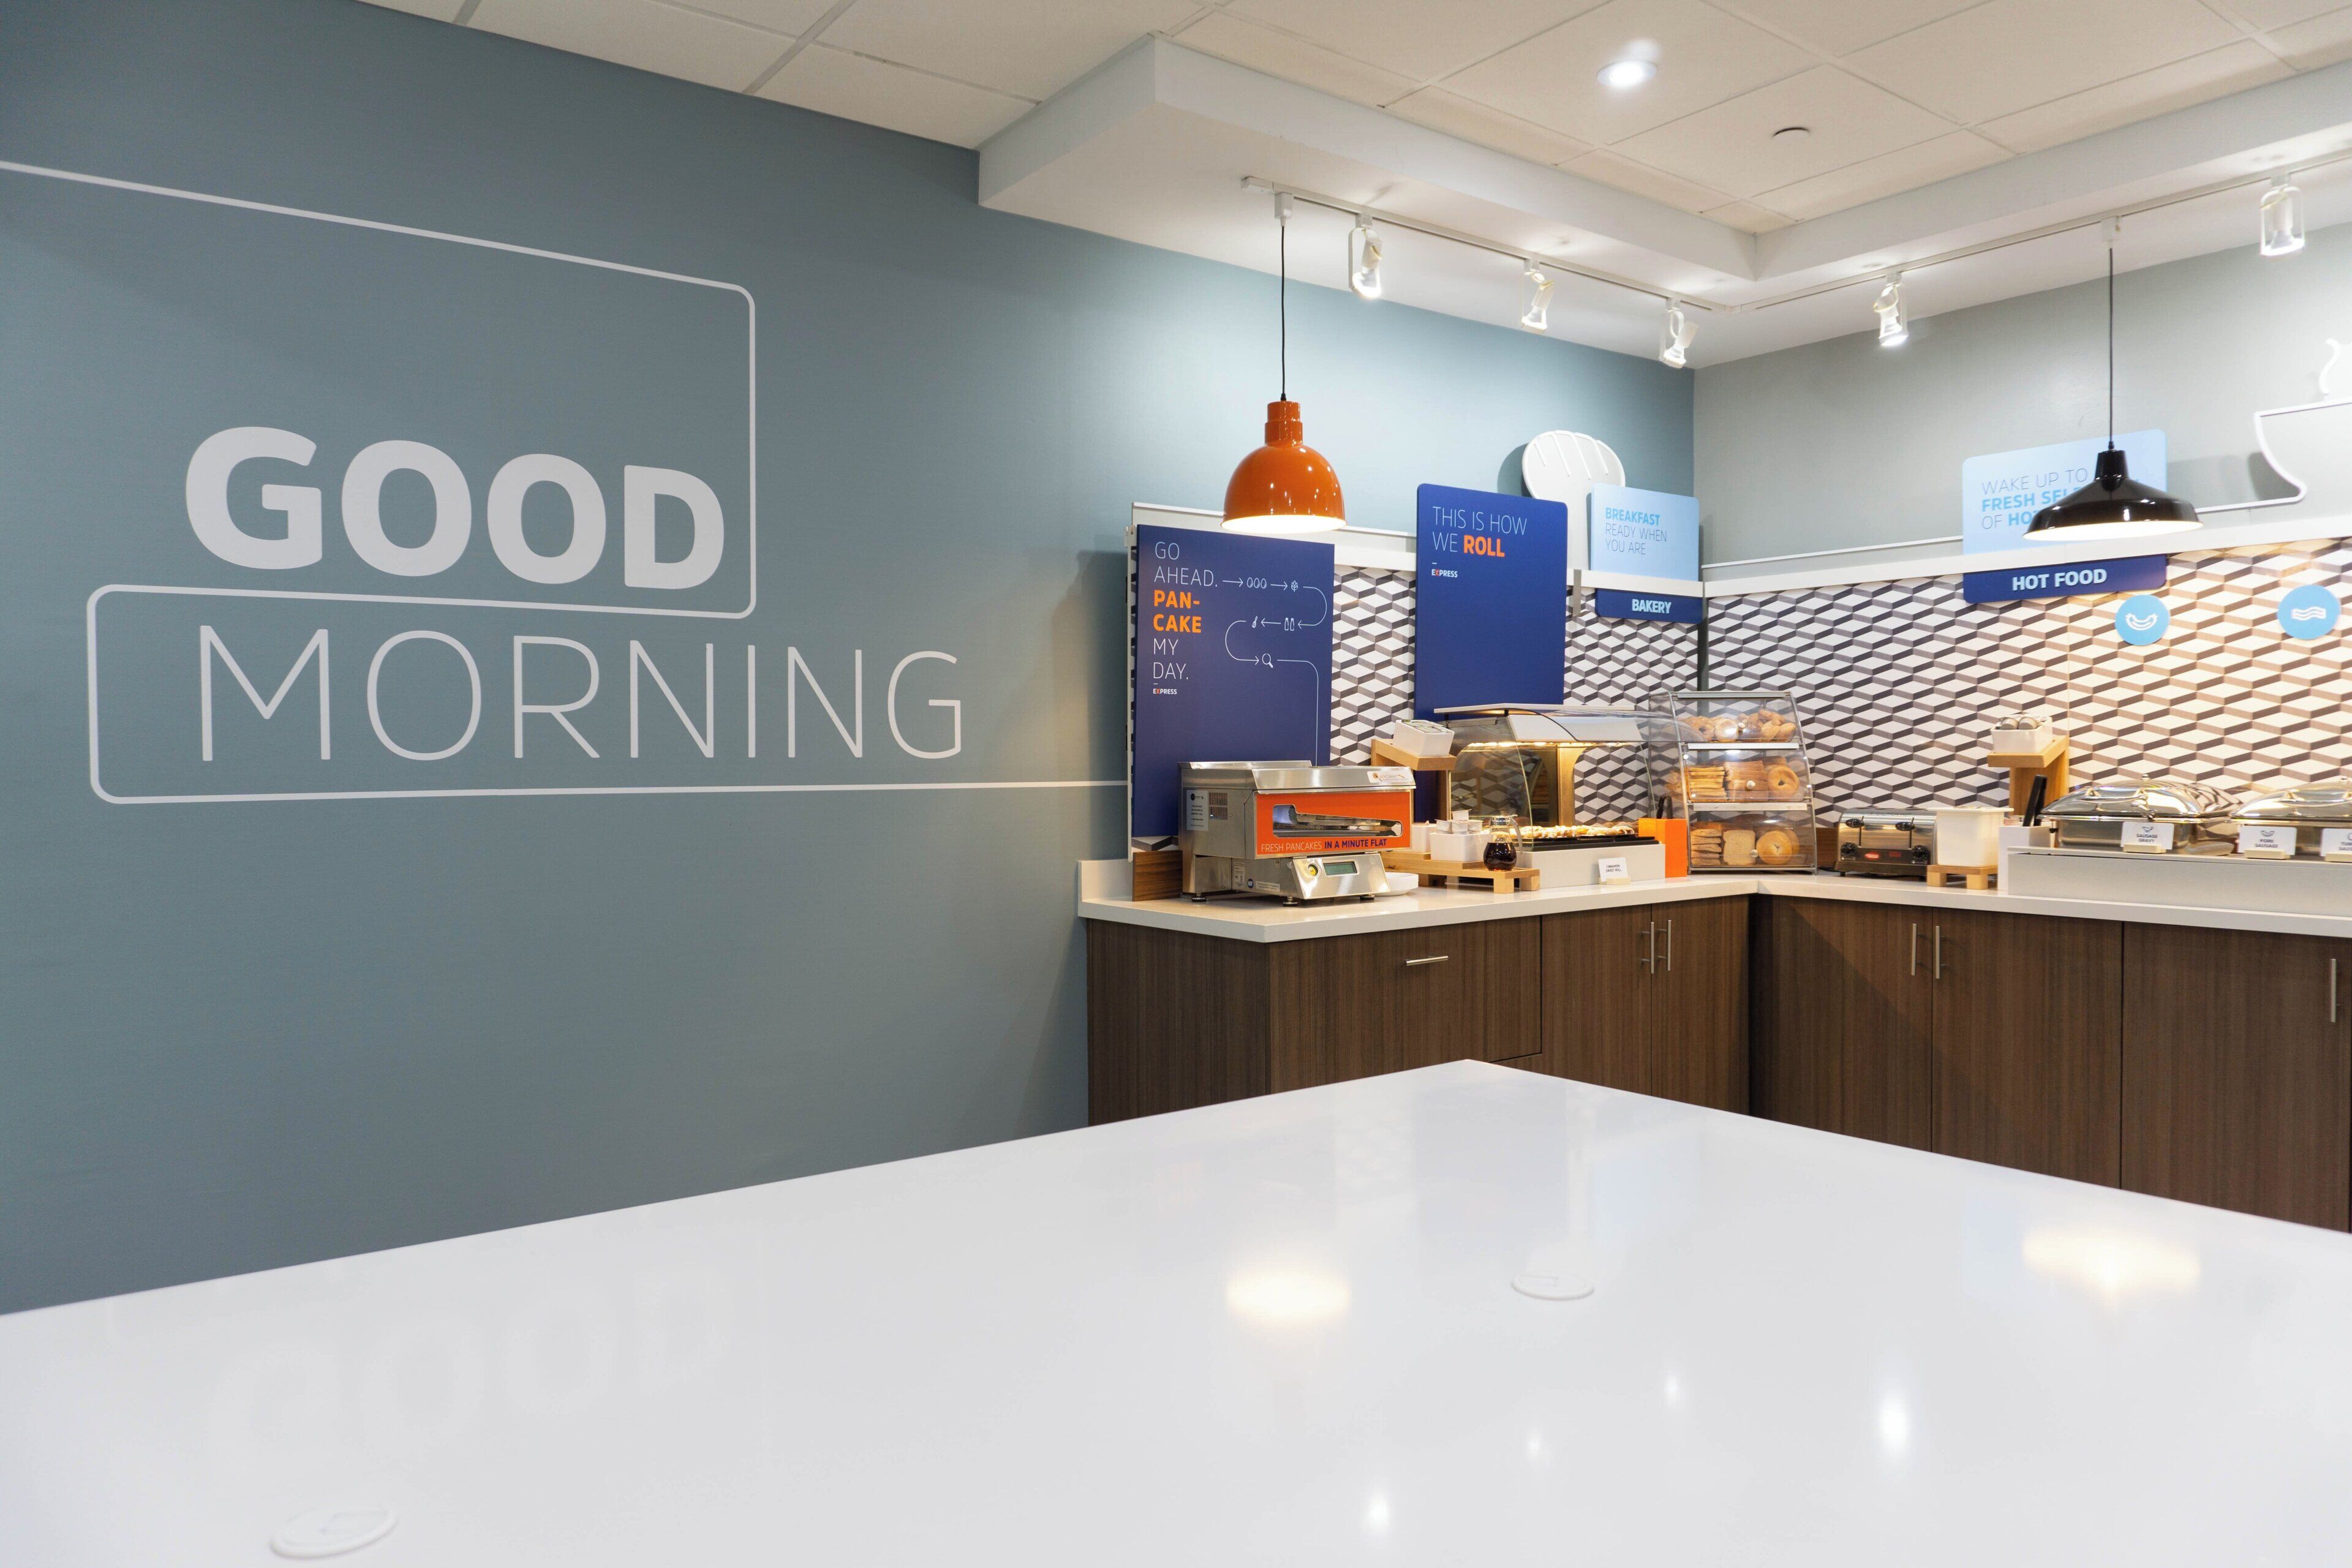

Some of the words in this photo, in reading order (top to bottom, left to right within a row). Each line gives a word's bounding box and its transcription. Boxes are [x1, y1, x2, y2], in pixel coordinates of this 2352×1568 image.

[1981, 476, 2029, 495] WAKE
[2037, 472, 2059, 488] UP
[2066, 468, 2088, 483] TO
[185, 426, 725, 590] GOOD
[1982, 492, 2035, 512] FRESH
[1433, 506, 1466, 529] THIS
[1472, 511, 1484, 532] IS
[1490, 514, 1528, 536] HOW
[1605, 507, 1660, 526] BREAKFAST
[1981, 514, 2002, 530] OF
[1605, 522, 1638, 539] READY
[1640, 529, 1667, 543] WHEN
[1155, 541, 1180, 560] GO
[1432, 531, 1458, 553] WE
[1463, 535, 1505, 557] ROLL
[1605, 538, 1626, 554] YOU
[1628, 542, 1646, 556] ARE
[1154, 565, 1218, 588] AHEAD.
[1431, 568, 1458, 578] EXPRESS
[2012, 574, 2051, 591] HOT
[2054, 568, 2107, 587] FOOD
[1154, 590, 1200, 609] PAN-
[1632, 598, 1672, 614] BAKERY
[1153, 613, 1202, 633] CAKE
[1153, 638, 1178, 656] MY
[1153, 662, 1189, 680] DAY.
[199, 625, 962, 762] MORNING
[1261, 843, 1283, 852] FRESH
[1286, 842, 1322, 851] PANCAKES
